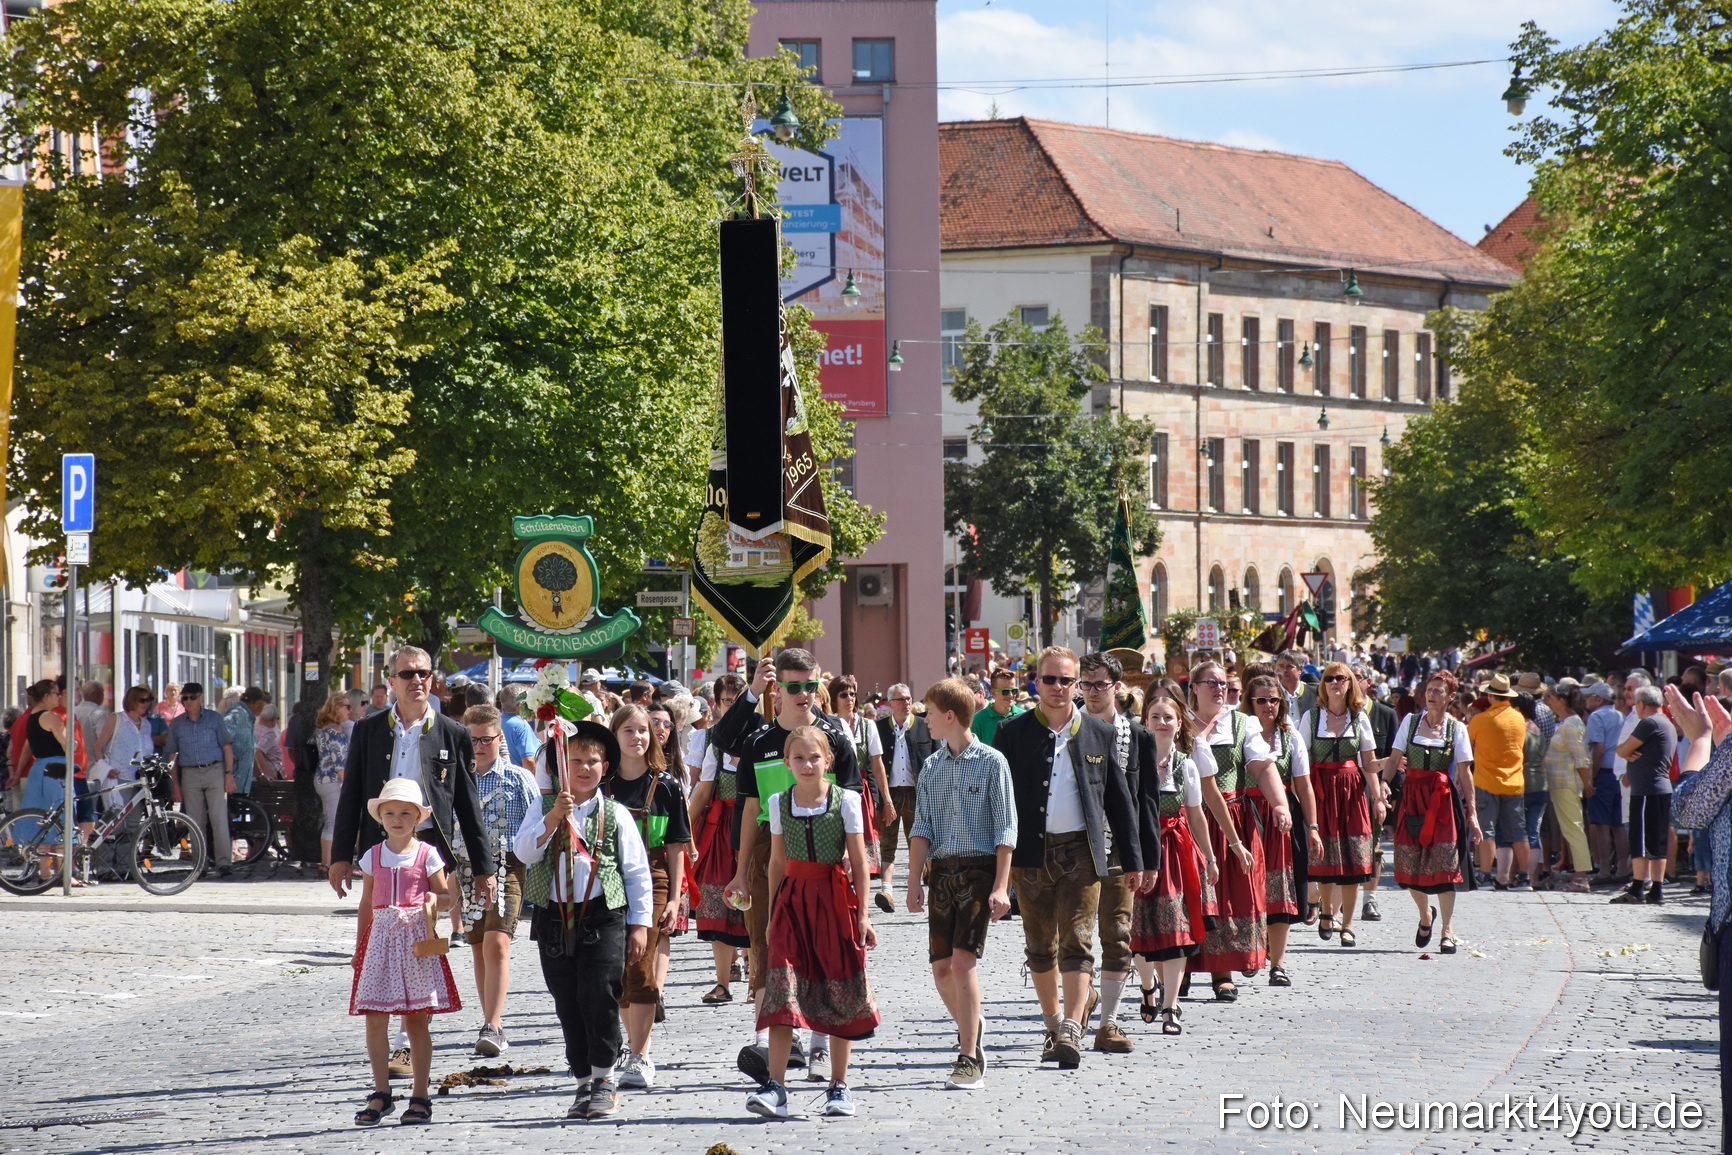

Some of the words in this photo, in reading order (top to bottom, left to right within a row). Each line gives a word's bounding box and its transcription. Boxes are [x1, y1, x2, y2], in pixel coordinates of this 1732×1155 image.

[782, 219, 828, 230] anzierung
[815, 344, 863, 366] net!
[785, 452, 813, 488] 1965
[70, 465, 87, 522] P
[640, 594, 679, 605] Rosengasse
[764, 750, 778, 758] JAKO
